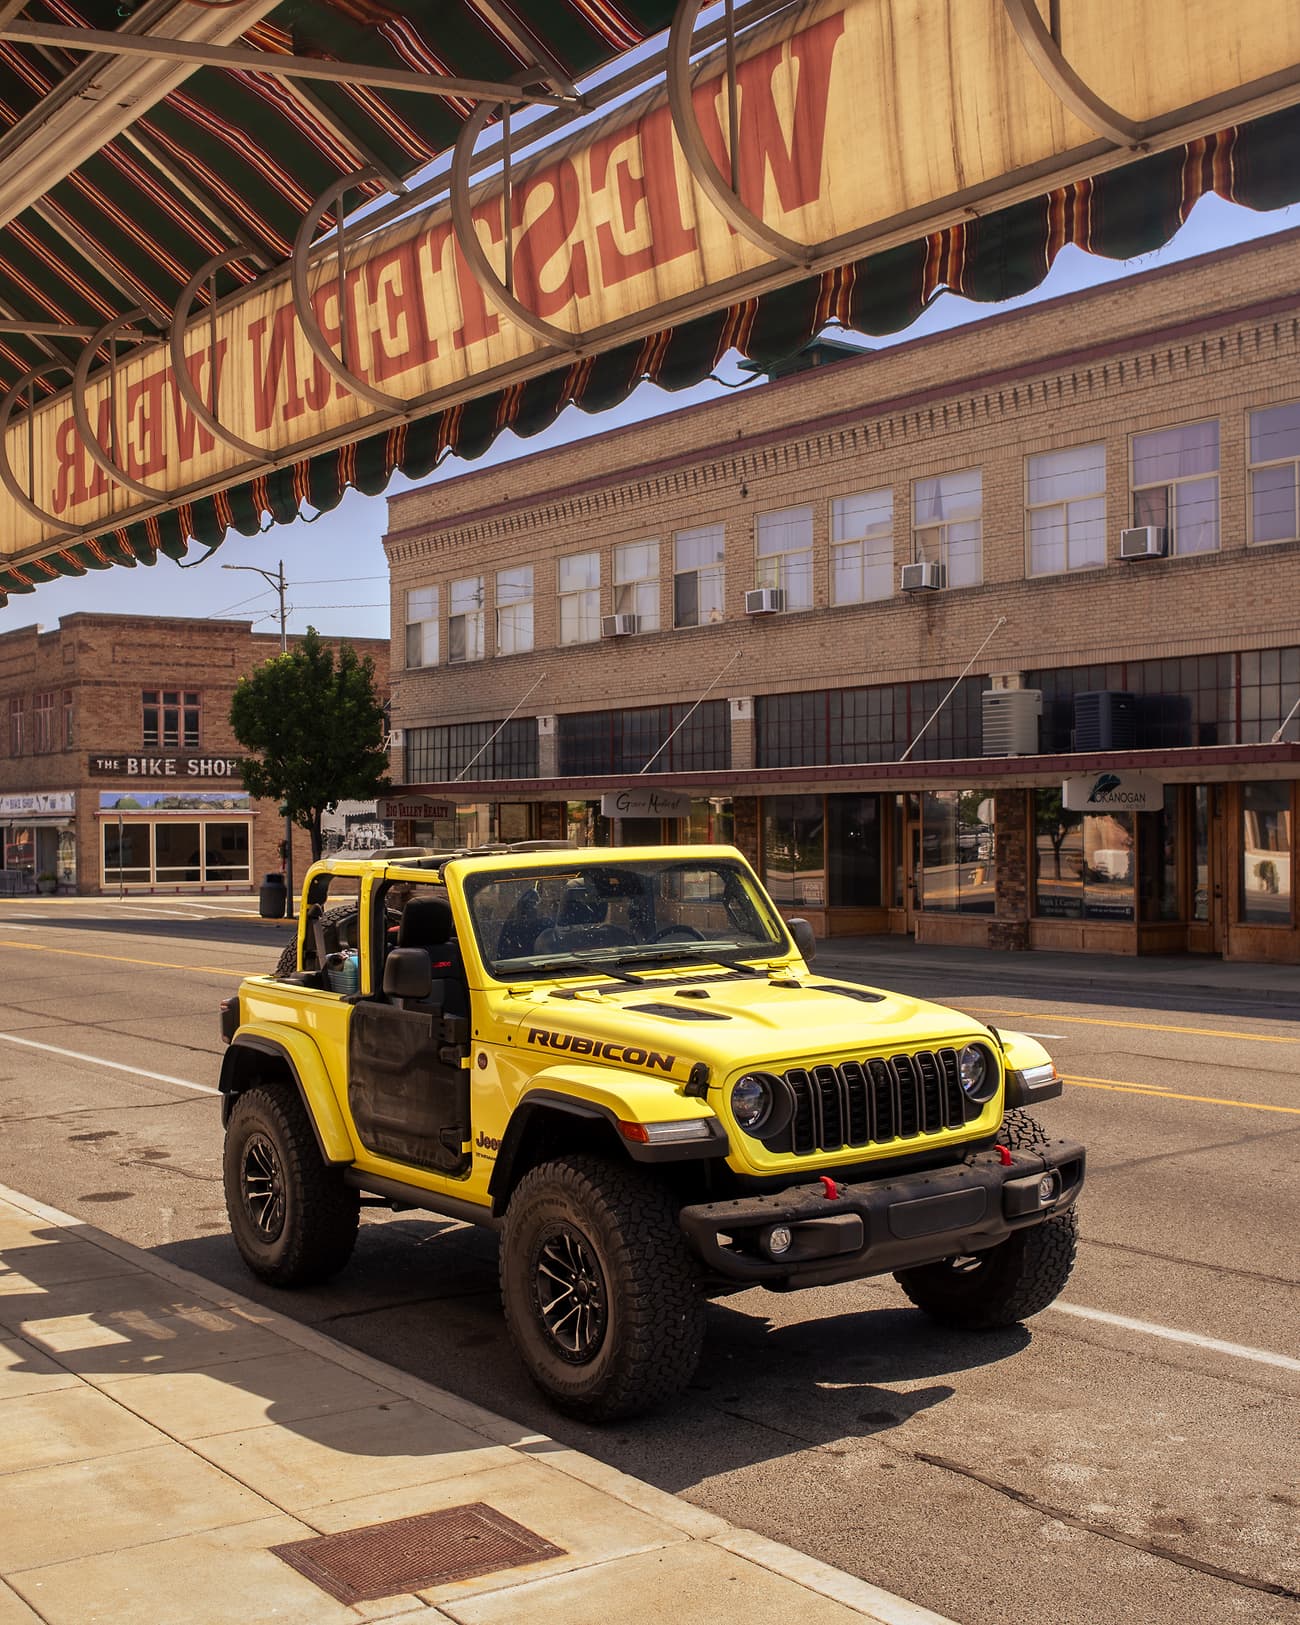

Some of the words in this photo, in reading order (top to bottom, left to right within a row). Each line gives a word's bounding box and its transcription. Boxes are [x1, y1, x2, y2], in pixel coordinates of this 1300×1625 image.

[96, 760, 120, 770] THE
[127, 758, 177, 776] BIKE
[1096, 791, 1146, 803] OKANOGAN
[398, 803, 422, 817] VALLEY
[423, 803, 448, 818] REALTY
[527, 1028, 676, 1073] RUBICON
